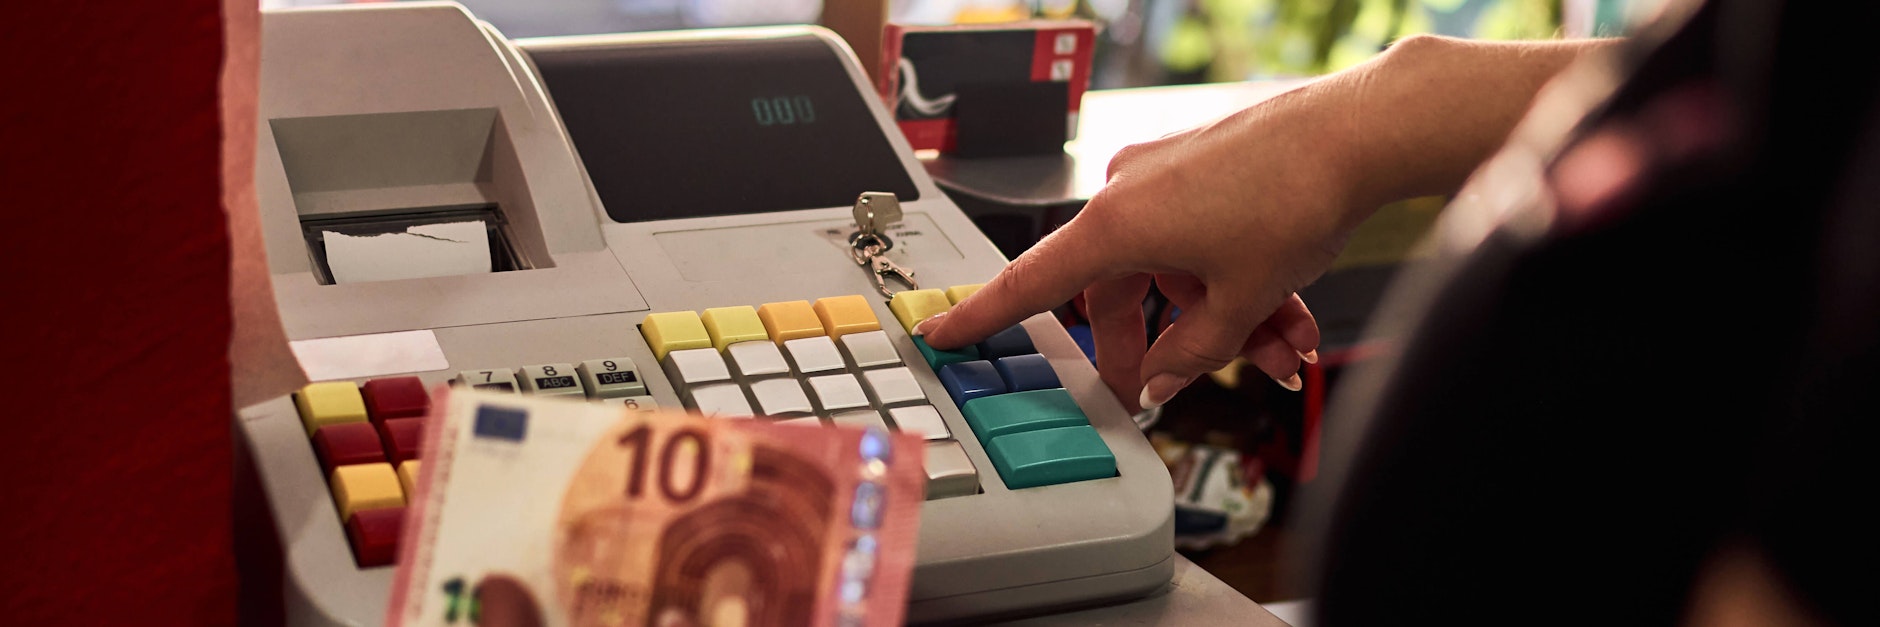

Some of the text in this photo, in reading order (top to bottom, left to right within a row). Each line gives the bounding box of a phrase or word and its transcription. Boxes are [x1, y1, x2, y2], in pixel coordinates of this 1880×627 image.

[542, 365, 558, 376] 8
[603, 360, 617, 371] 9
[479, 371, 493, 382] 7
[602, 373, 629, 384] DEF
[543, 378, 571, 388] ABC
[624, 399, 639, 410] 6
[616, 423, 712, 503] 10
